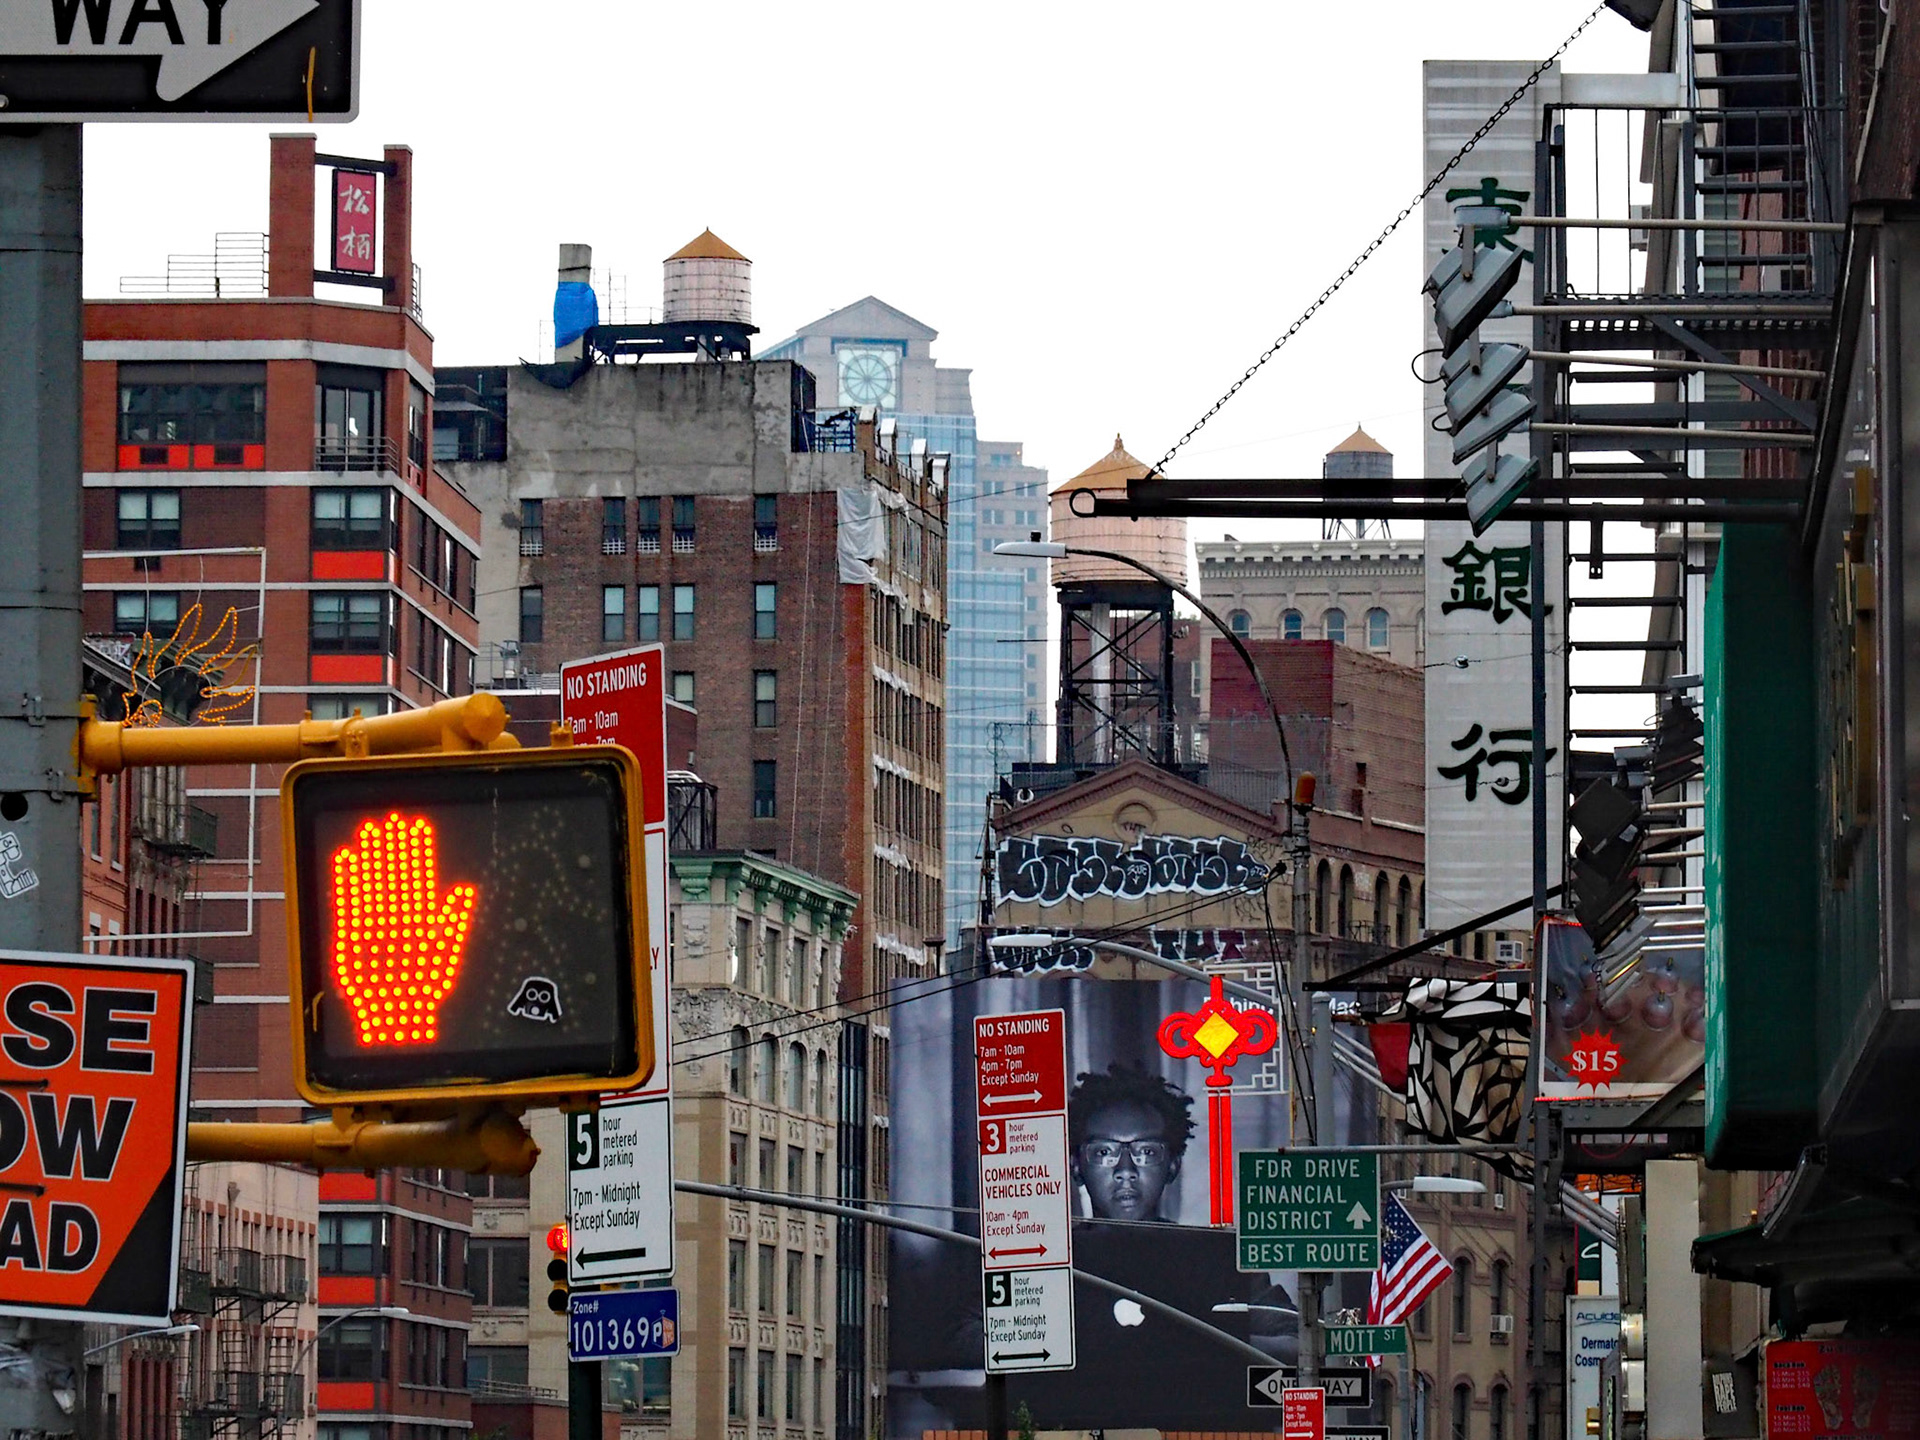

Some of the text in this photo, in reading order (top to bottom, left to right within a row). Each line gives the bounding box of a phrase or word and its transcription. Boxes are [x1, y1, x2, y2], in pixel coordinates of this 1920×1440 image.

[566, 662, 647, 700] NO STANDING
[594, 710, 618, 731] 10am
[979, 1018, 1050, 1038] NO STANDING
[980, 1046, 997, 1058] 7am
[1004, 1044, 1025, 1056] 10am
[981, 1060, 999, 1074] 4pm
[1005, 1058, 1023, 1071] 7pm
[1572, 1050, 1618, 1072] $15
[981, 1071, 1039, 1087] Except Sunday
[602, 1117, 622, 1132] hour
[1008, 1122, 1025, 1132] hour
[576, 1113, 593, 1165] 5
[602, 1130, 638, 1149] metered
[986, 1123, 1000, 1153] 3
[1009, 1132, 1039, 1143] metered
[1009, 1143, 1036, 1155] parking
[603, 1150, 634, 1171] parking
[1255, 1159, 1360, 1178] FDR DRIVE
[984, 1165, 1050, 1182] COMMERCIAL
[573, 1188, 593, 1210] 7pm
[602, 1180, 641, 1205] Midnight
[985, 1181, 1061, 1199] VEHICLES ONLY
[1247, 1185, 1347, 1204] FINANCIAL
[574, 1207, 640, 1233] Except Sunday
[986, 1211, 1005, 1222] 10am
[1012, 1209, 1029, 1221] 4pm
[1247, 1210, 1333, 1230] DISTRICT
[987, 1223, 1046, 1237] Except Sunday
[1248, 1243, 1369, 1263] BEST ROUTE
[992, 1275, 1006, 1305] 5
[1014, 1276, 1030, 1286] hour
[1014, 1285, 1044, 1296] metered
[573, 1300, 599, 1314] Zone#
[1015, 1296, 1040, 1308] parking
[990, 1317, 1006, 1330] 7pm
[1013, 1314, 1047, 1328] Midnight
[573, 1316, 649, 1353] 101369
[991, 1328, 1046, 1344] Except Sunday
[1330, 1328, 1397, 1353] MOTT ST
[1285, 1391, 1319, 1401] NO STANDING
